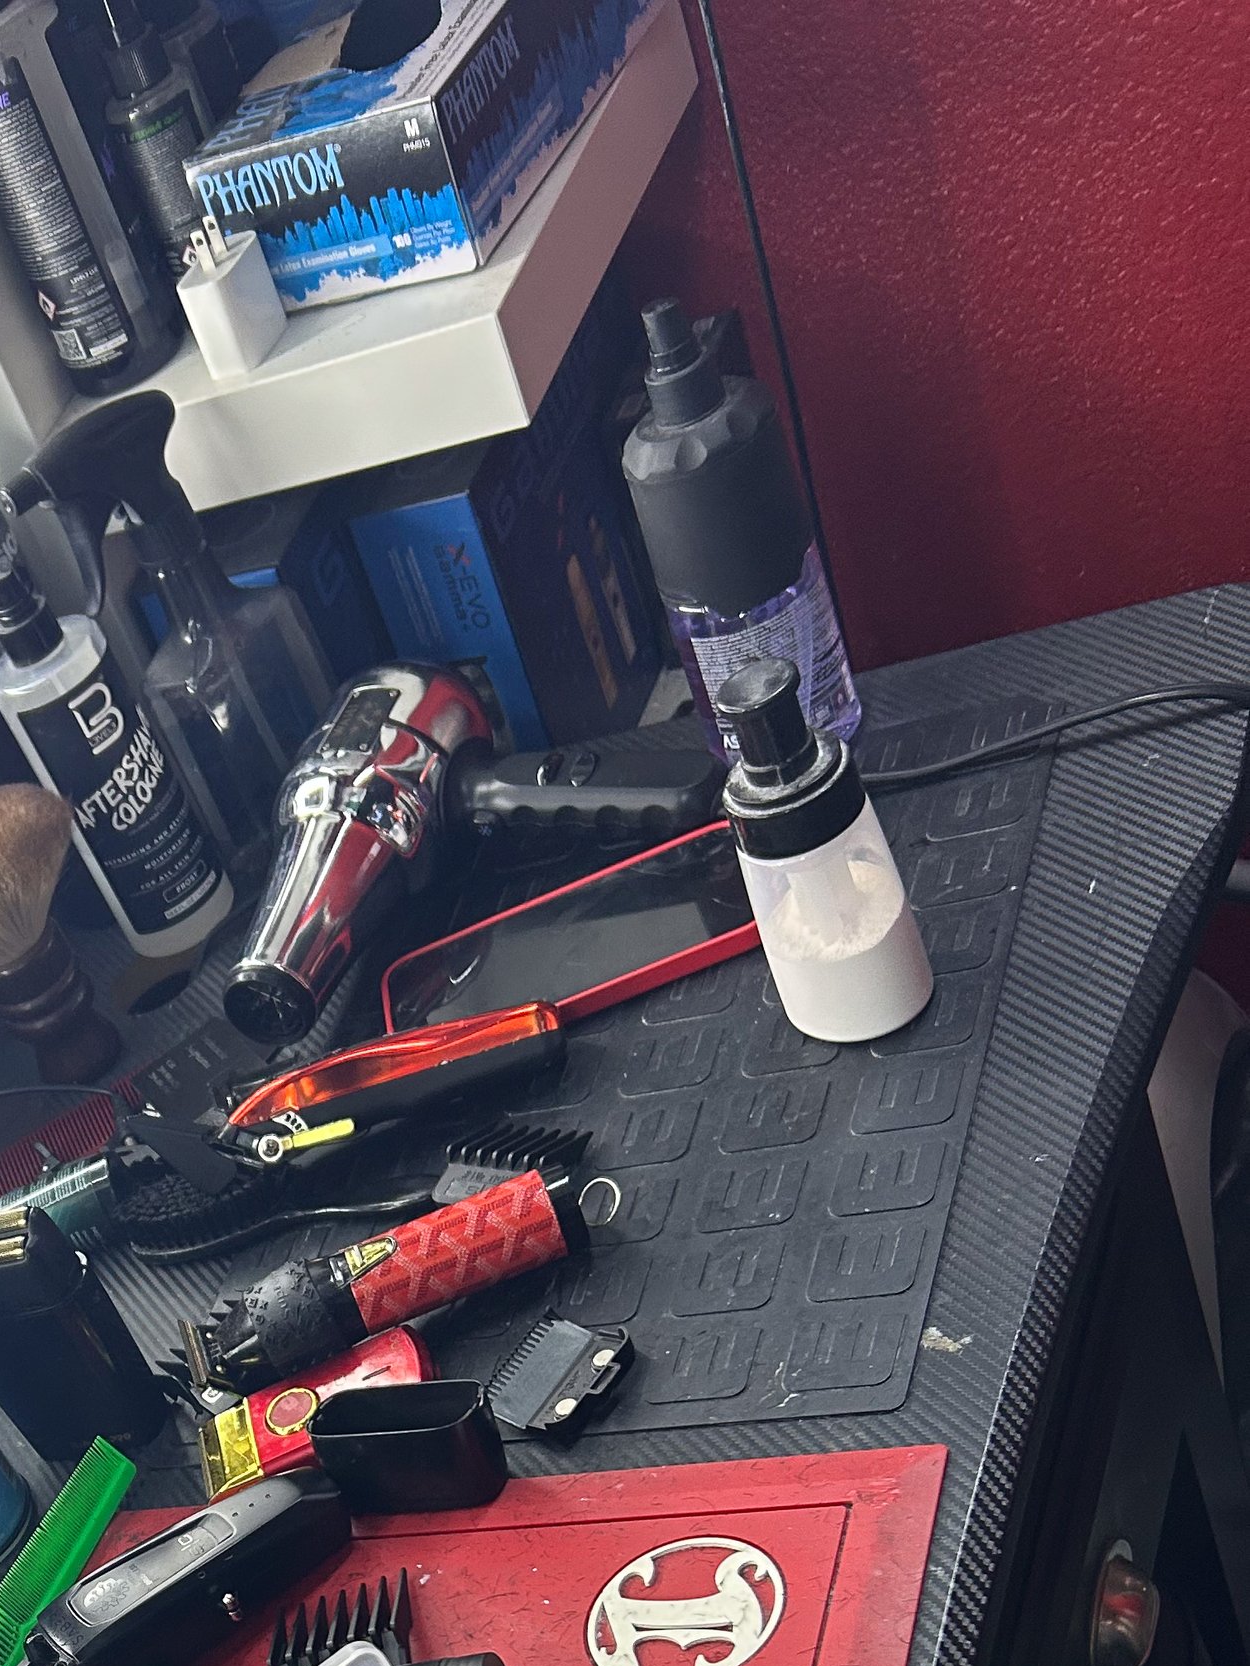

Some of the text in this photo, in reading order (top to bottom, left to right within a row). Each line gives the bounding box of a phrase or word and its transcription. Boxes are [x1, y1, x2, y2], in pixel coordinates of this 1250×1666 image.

[403, 118, 421, 139] M
[348, 241, 378, 260] Gloves
[445, 540, 493, 631] X-EVO
